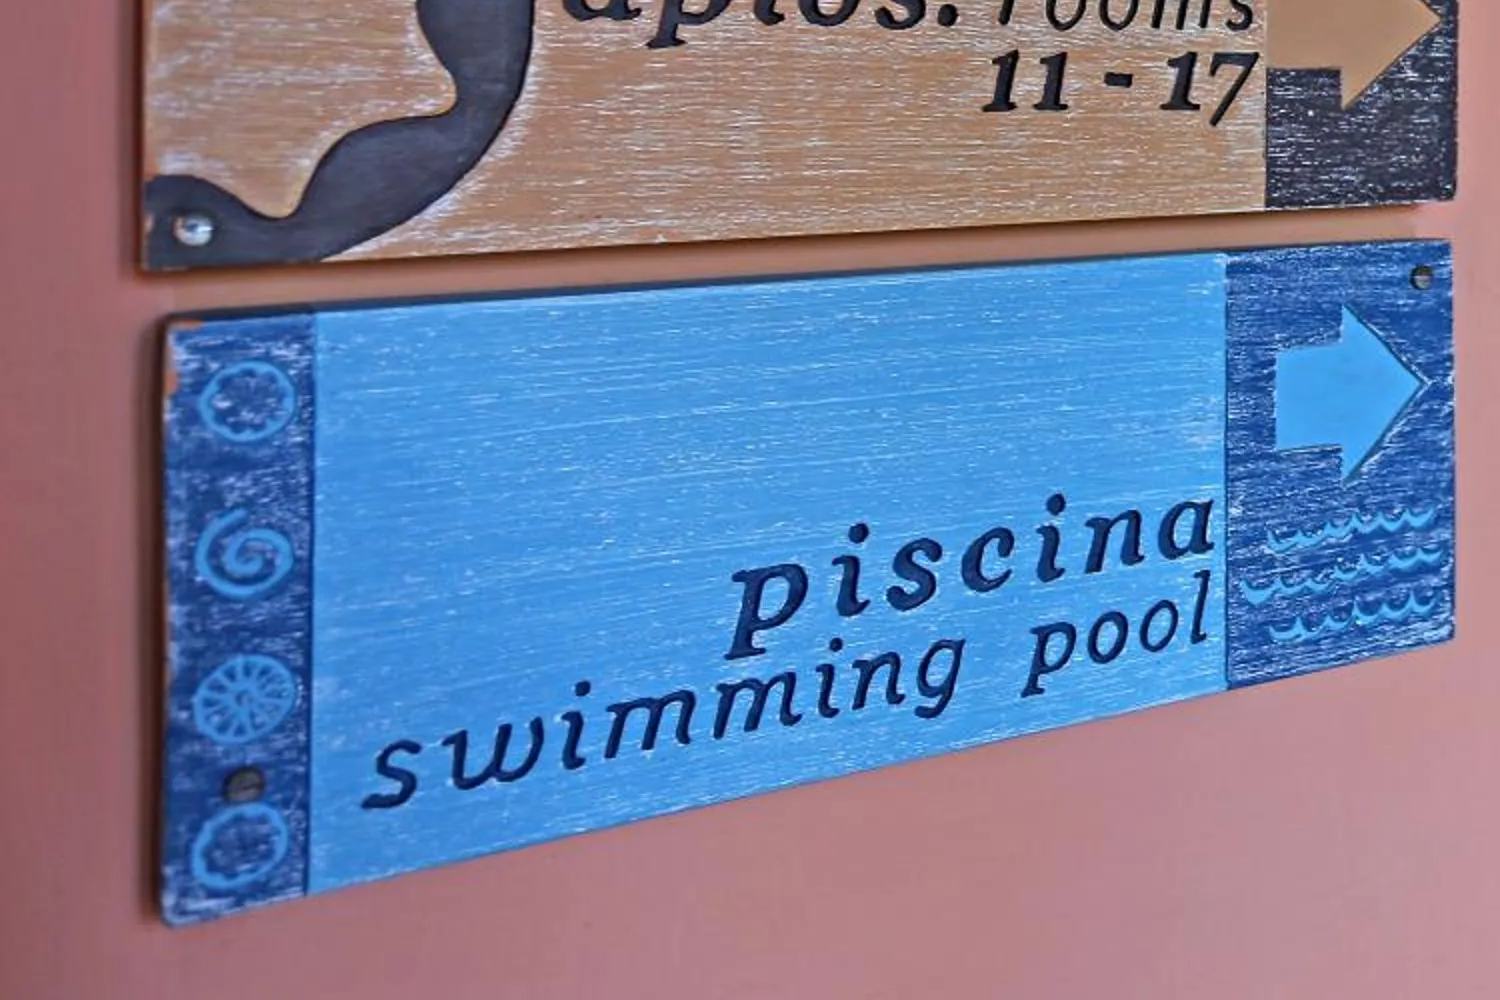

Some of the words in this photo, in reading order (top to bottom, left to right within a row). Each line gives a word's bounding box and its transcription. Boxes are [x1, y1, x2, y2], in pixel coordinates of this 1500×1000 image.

[724, 492, 1215, 661] piscina
[360, 636, 966, 810] swimming
[1020, 570, 1211, 698] pool
